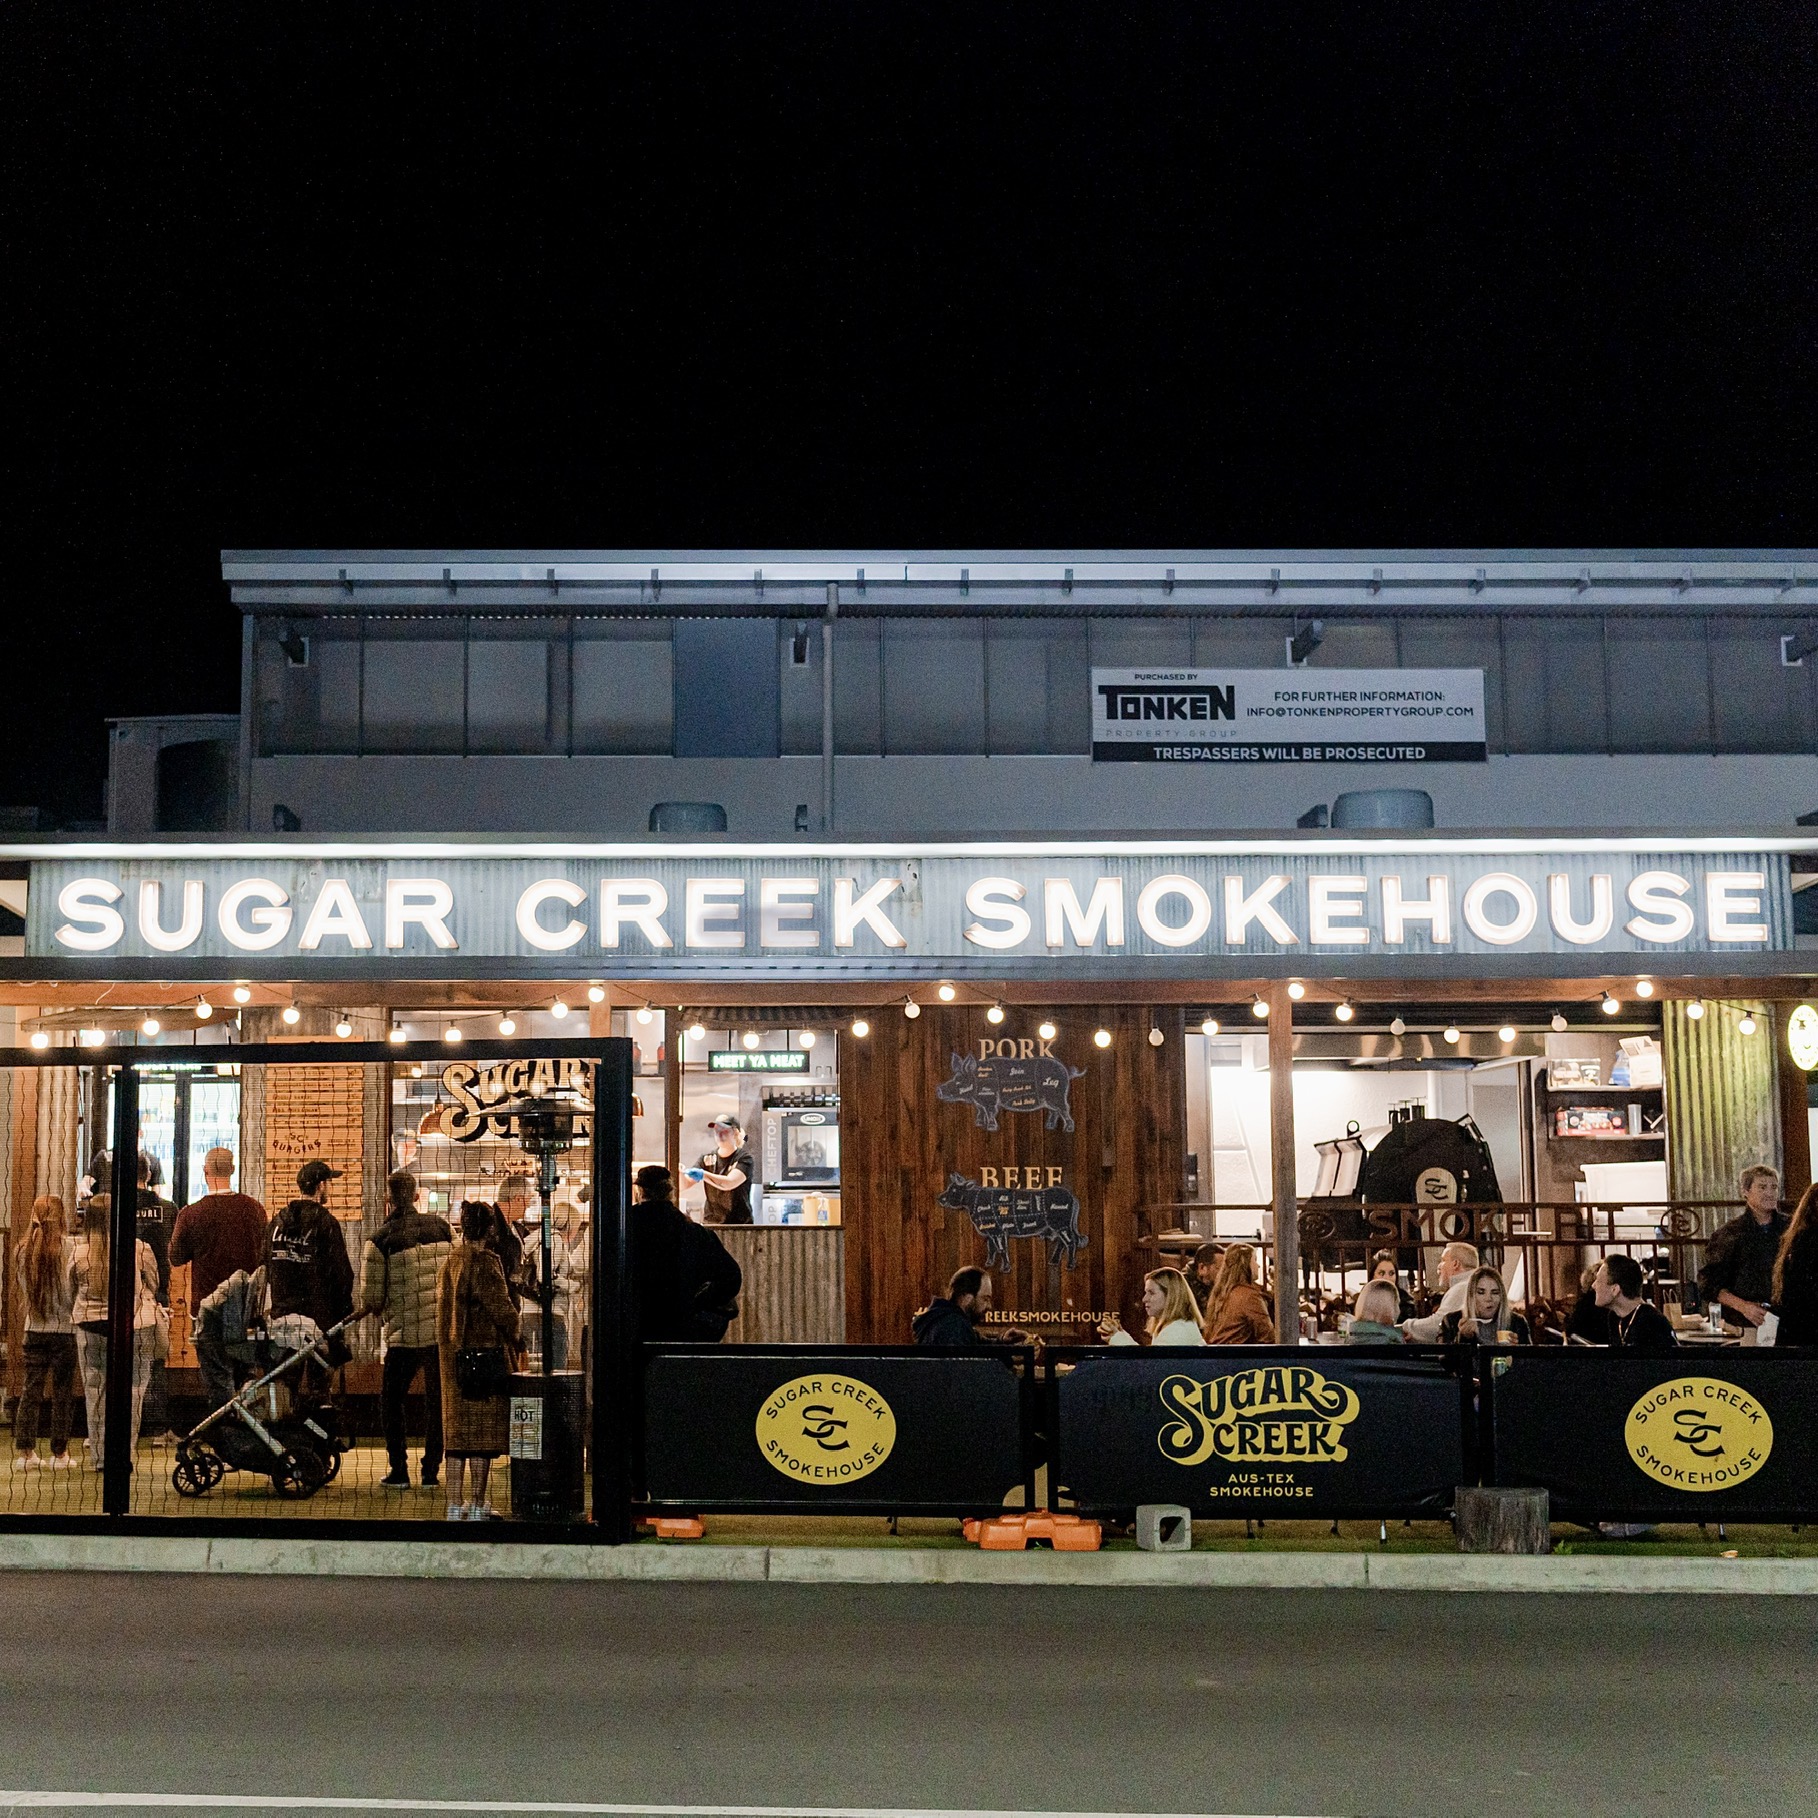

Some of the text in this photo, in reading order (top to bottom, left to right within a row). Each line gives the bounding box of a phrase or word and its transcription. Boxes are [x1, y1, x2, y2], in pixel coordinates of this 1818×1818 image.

[1134, 673, 1198, 681] PURCHASED BY
[1098, 685, 1236, 721] TONKEN
[1274, 691, 1446, 702] FOR FURTHER INFORMATION:
[1246, 707, 1474, 717] INFO@TONKENPROPERTYGROUP.COM
[1105, 730, 1237, 738] PROPERTY GROUP
[1154, 747, 1426, 760] TRESPASSERS WILL BE PROSECUTED
[54, 871, 1770, 951] SUGAR CREEK SMOKEHOUSE
[713, 1054, 805, 1068] MEET YA MEAT
[978, 1039, 1055, 1061] PORK
[767, 1118, 777, 1175] CHEFTOP
[980, 1166, 1063, 1190] BEEF
[1368, 1207, 1534, 1242] SMOKE
[1555, 1206, 1625, 1242] PIT
[984, 1310, 1121, 1323] REEKSMOKEHOUSE
[766, 1381, 887, 1420] SUGAR CREEK
[1635, 1385, 1763, 1425] SUGAR CREEK
[1158, 1367, 1361, 1466] SUGAR
[1212, 1420, 1349, 1463] CREEK
[766, 1439, 885, 1478] SMOKEHOUSE
[1636, 1445, 1762, 1485] SMOKEHOUSE
[1227, 1473, 1295, 1484] AUS-TEX
[1209, 1486, 1314, 1497] SMOKEHOUSE
